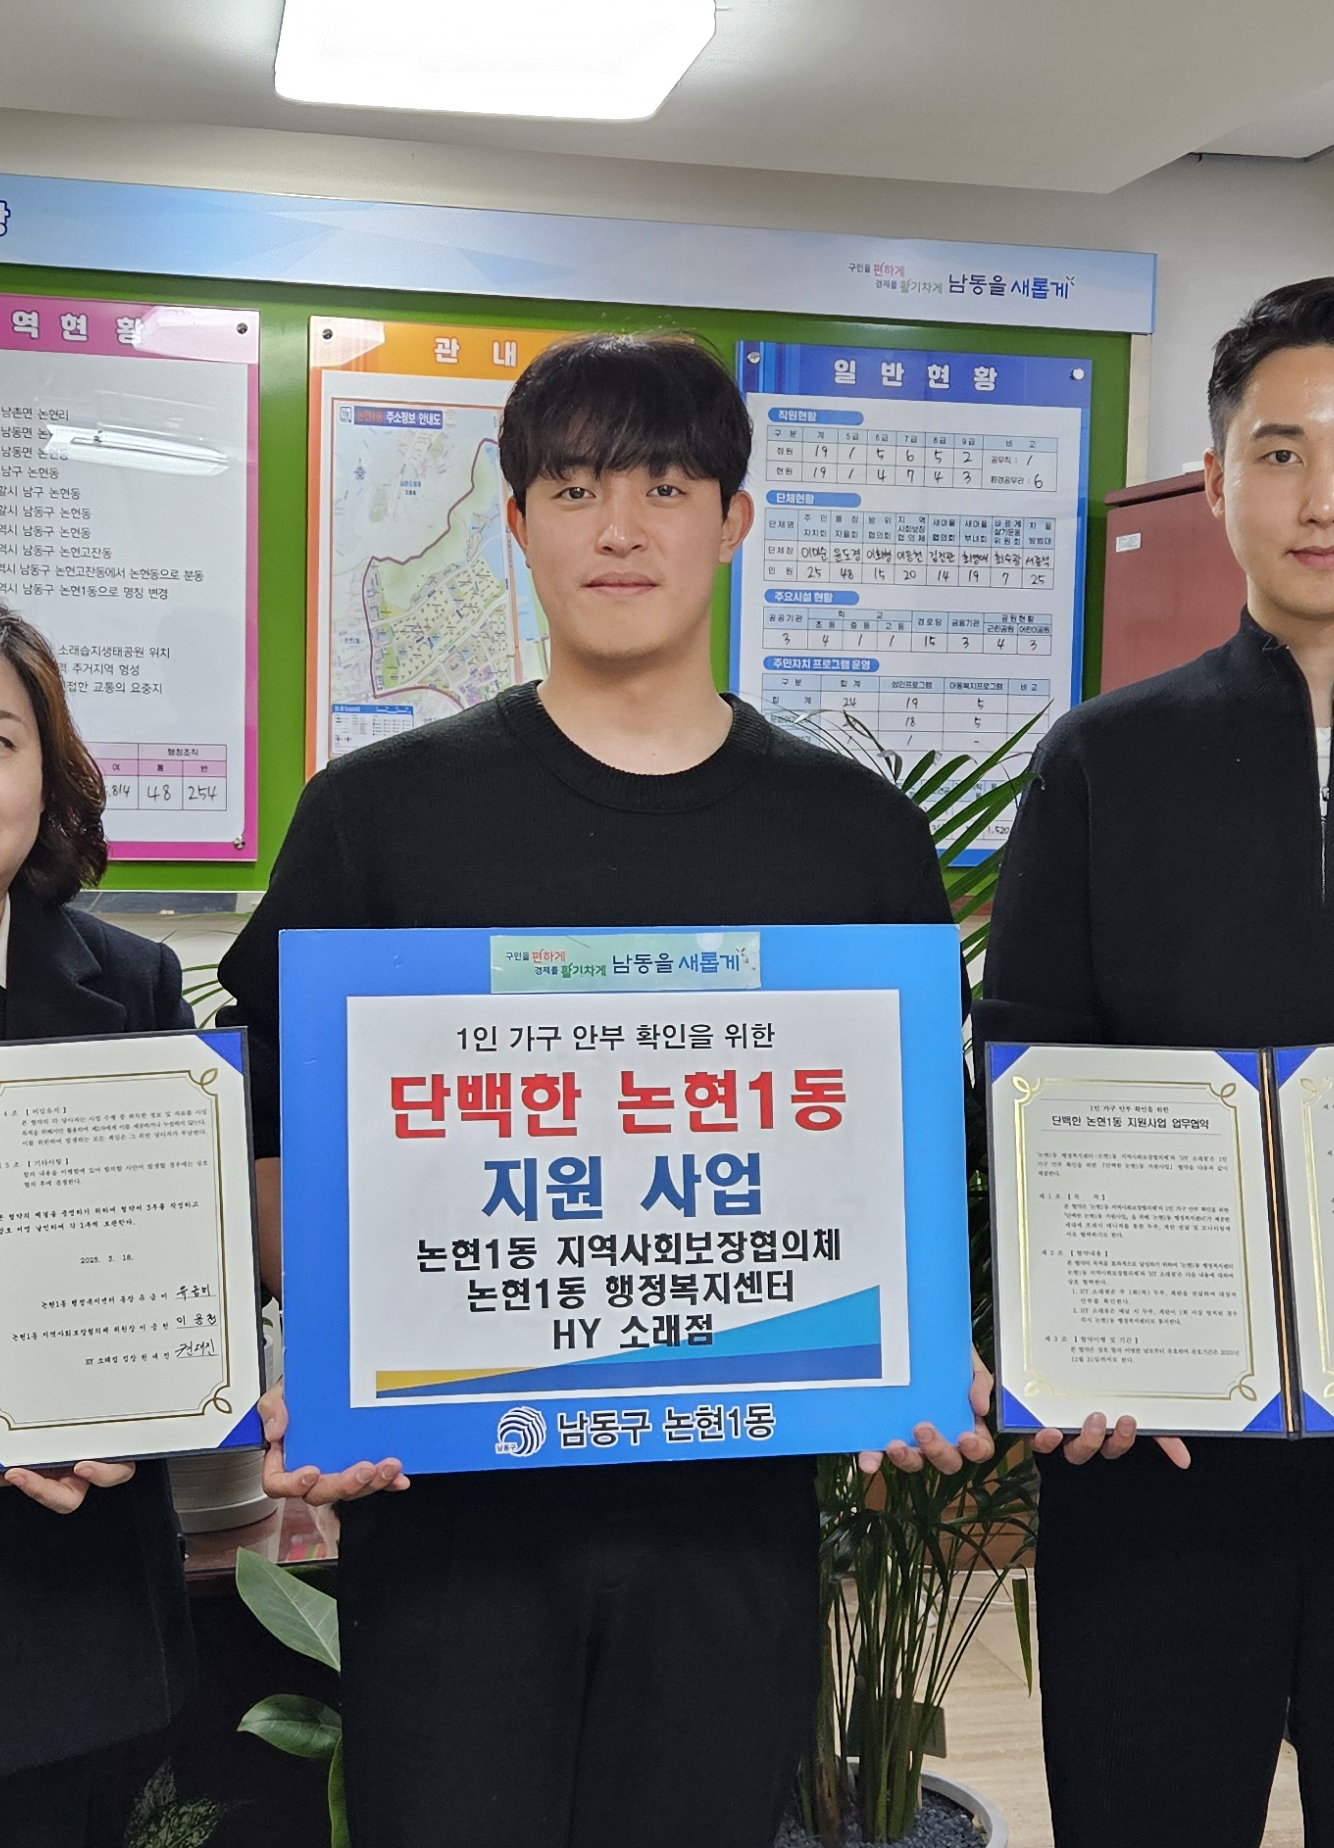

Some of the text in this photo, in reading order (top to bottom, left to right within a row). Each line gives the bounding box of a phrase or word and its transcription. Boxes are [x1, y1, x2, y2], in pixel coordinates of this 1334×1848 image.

[849, 262, 904, 277] 구민을 편하게
[900, 279, 942, 294] 활기차게
[949, 274, 1070, 299] 남동을 새롭게
[434, 337, 518, 368] 관 내
[835, 360, 997, 391] 일 반 현 황
[38, 409, 68, 421] 논현리
[386, 411, 416, 424] 주소정보
[419, 413, 441, 425] 안내도
[1, 466, 22, 477] 남구
[27, 467, 59, 479] 논현동
[23, 506, 55, 518] 남동구
[60, 507, 91, 520] 논현동
[23, 525, 54, 537] 남동구
[60, 527, 91, 539] 논현동
[23, 545, 54, 557] 남동구
[60, 546, 112, 559] 논현고잔동
[20, 564, 50, 576] 남동구
[55, 566, 125, 578] 논현고잔동에서
[130, 568, 179, 580] 논현동으로
[184, 570, 204, 582] 분동
[807, 566, 885, 580] 25 15
[938, 570, 1045, 584] 14 19 25
[23, 584, 167, 600] 남동구 논현1동으로 명칭 변경
[58, 645, 169, 659] 소래습지생태공원 위치
[72, 663, 139, 676] 주거지역 형성
[812, 658, 851, 671] 프로그램
[93, 682, 162, 694] 교통의 요충지
[147, 784, 217, 801] 48 254
[506, 949, 565, 963] 구민을 편하게
[613, 952, 739, 974] 남동을 새롭게
[535, 963, 606, 978] 경제를 활기차게
[457, 1023, 775, 1052] 1인 가구 안부 확인을 위한
[391, 1069, 846, 1139] 단백한 논현1동
[1052, 1116, 1209, 1129] 단백한 논현1동 지원사업 업무협약
[482, 1153, 761, 1221] 지원 사업
[417, 1229, 840, 1272] 논현1동 지역사회보장협의체
[468, 1270, 793, 1312] 논현1동 행정복지센터
[554, 1314, 715, 1350] HY 소래점
[557, 1403, 776, 1449] 남동구 논현1동
